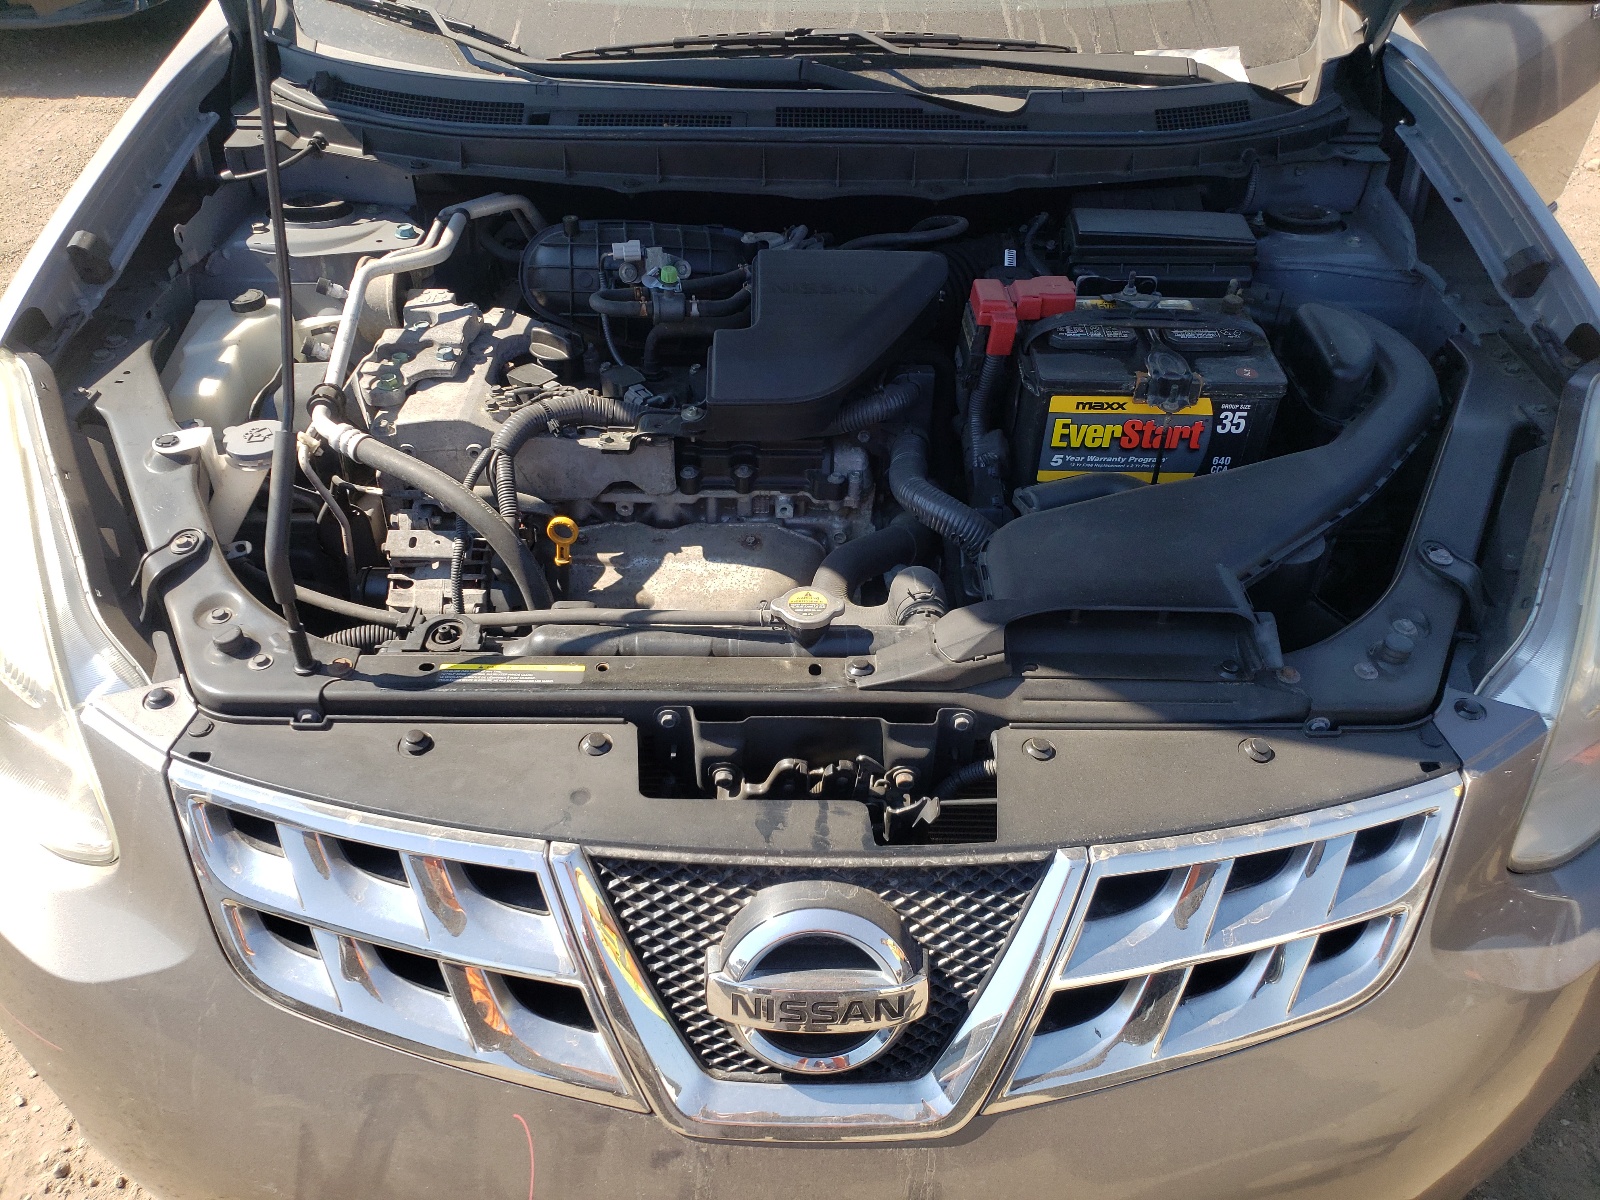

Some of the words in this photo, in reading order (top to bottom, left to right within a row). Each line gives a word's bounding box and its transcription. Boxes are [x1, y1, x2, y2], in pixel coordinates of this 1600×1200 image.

[771, 283, 878, 297] NISSAN
[1075, 401, 1128, 411] maxx
[1216, 411, 1248, 434] 35
[1051, 418, 1205, 449] EverStart
[1050, 454, 1064, 467] 5
[1212, 456, 1232, 466] 640
[1210, 466, 1229, 475] CCA
[731, 992, 905, 1025] NISSAN
